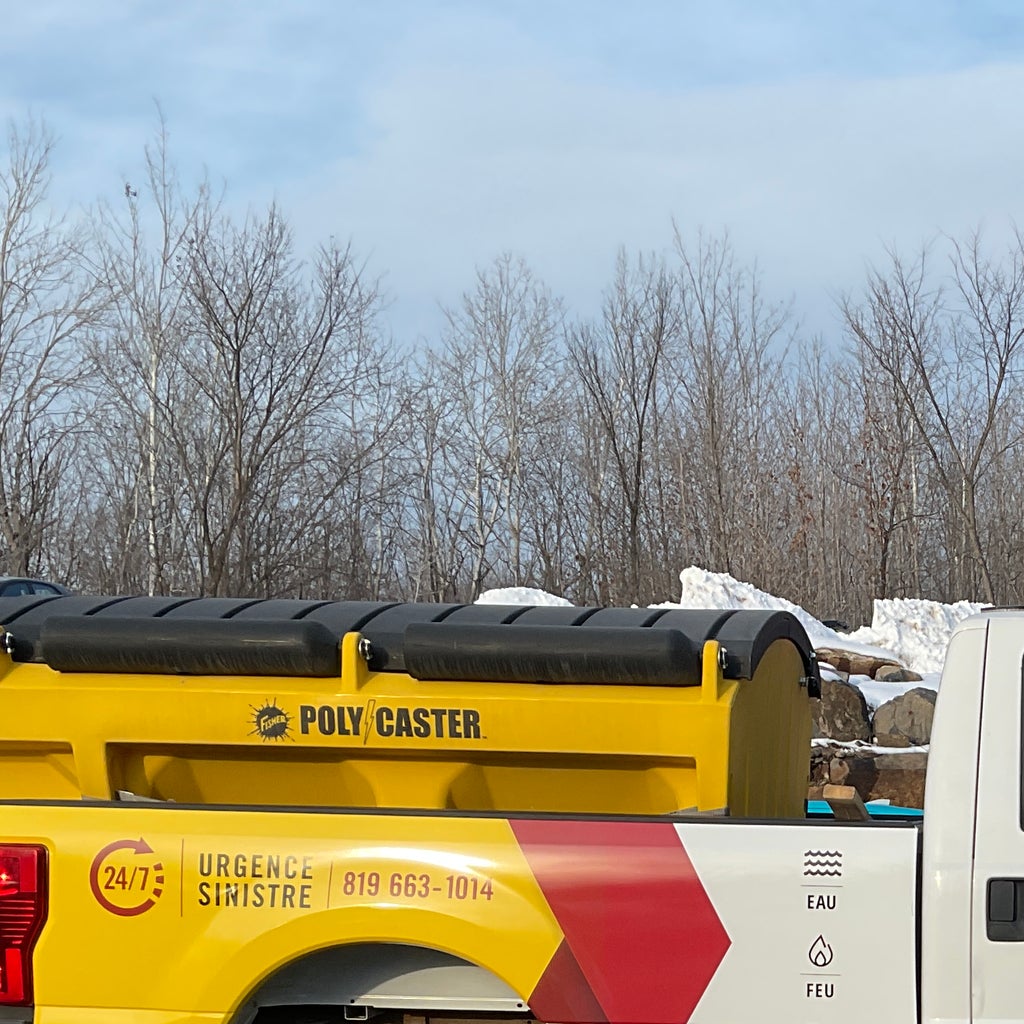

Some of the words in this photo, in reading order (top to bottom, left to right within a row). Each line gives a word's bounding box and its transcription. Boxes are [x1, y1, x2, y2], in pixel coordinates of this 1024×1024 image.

[260, 715, 287, 732] FISHER
[300, 705, 364, 736] POLY
[104, 866, 150, 891] 24/7
[199, 853, 313, 880] URGENCE
[198, 882, 312, 909] SINISTRE
[343, 871, 381, 897] 819
[389, 872, 494, 900] 663-1014
[807, 895, 836, 910] EAU
[806, 983, 835, 998] FEU
